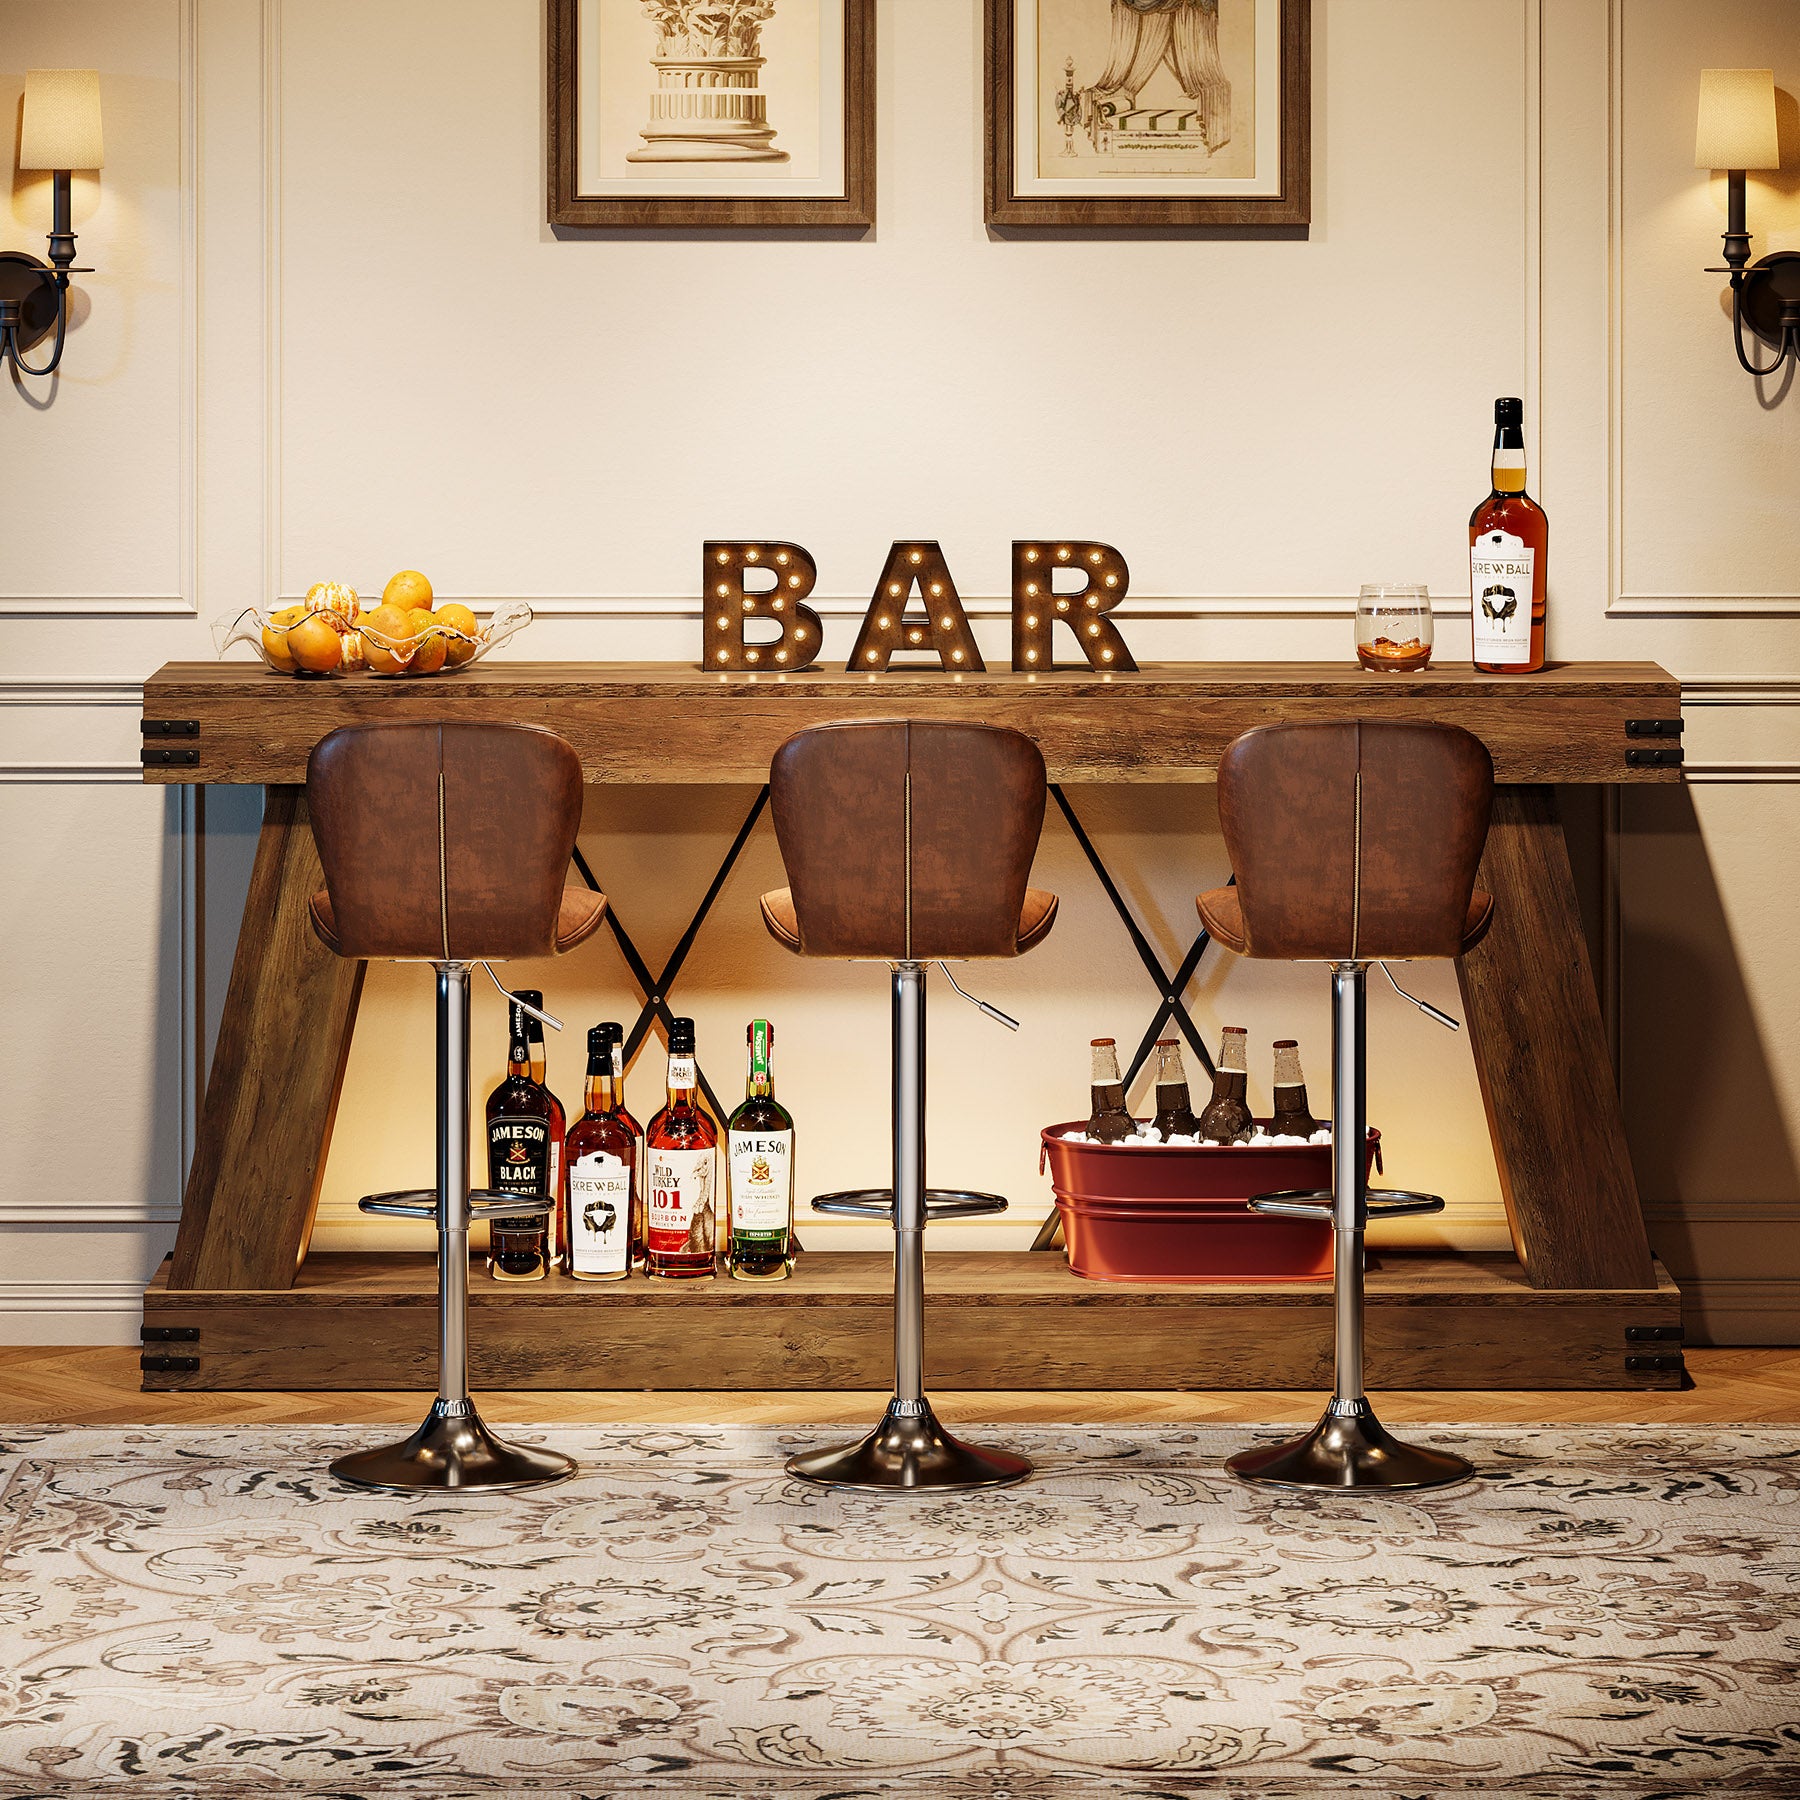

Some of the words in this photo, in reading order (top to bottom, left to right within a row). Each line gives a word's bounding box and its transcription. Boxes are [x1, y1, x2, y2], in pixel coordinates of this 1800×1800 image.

[1472, 562, 1531, 576] SKREWBALL
[703, 540, 1140, 673] BAR
[755, 1030, 765, 1065] JAMESON
[492, 1126, 545, 1142] JAMESON
[734, 1140, 787, 1157] JAMESON
[500, 1166, 537, 1180] BLACK
[572, 1180, 627, 1192] SKREWBALL
[652, 1188, 683, 1210] 101
